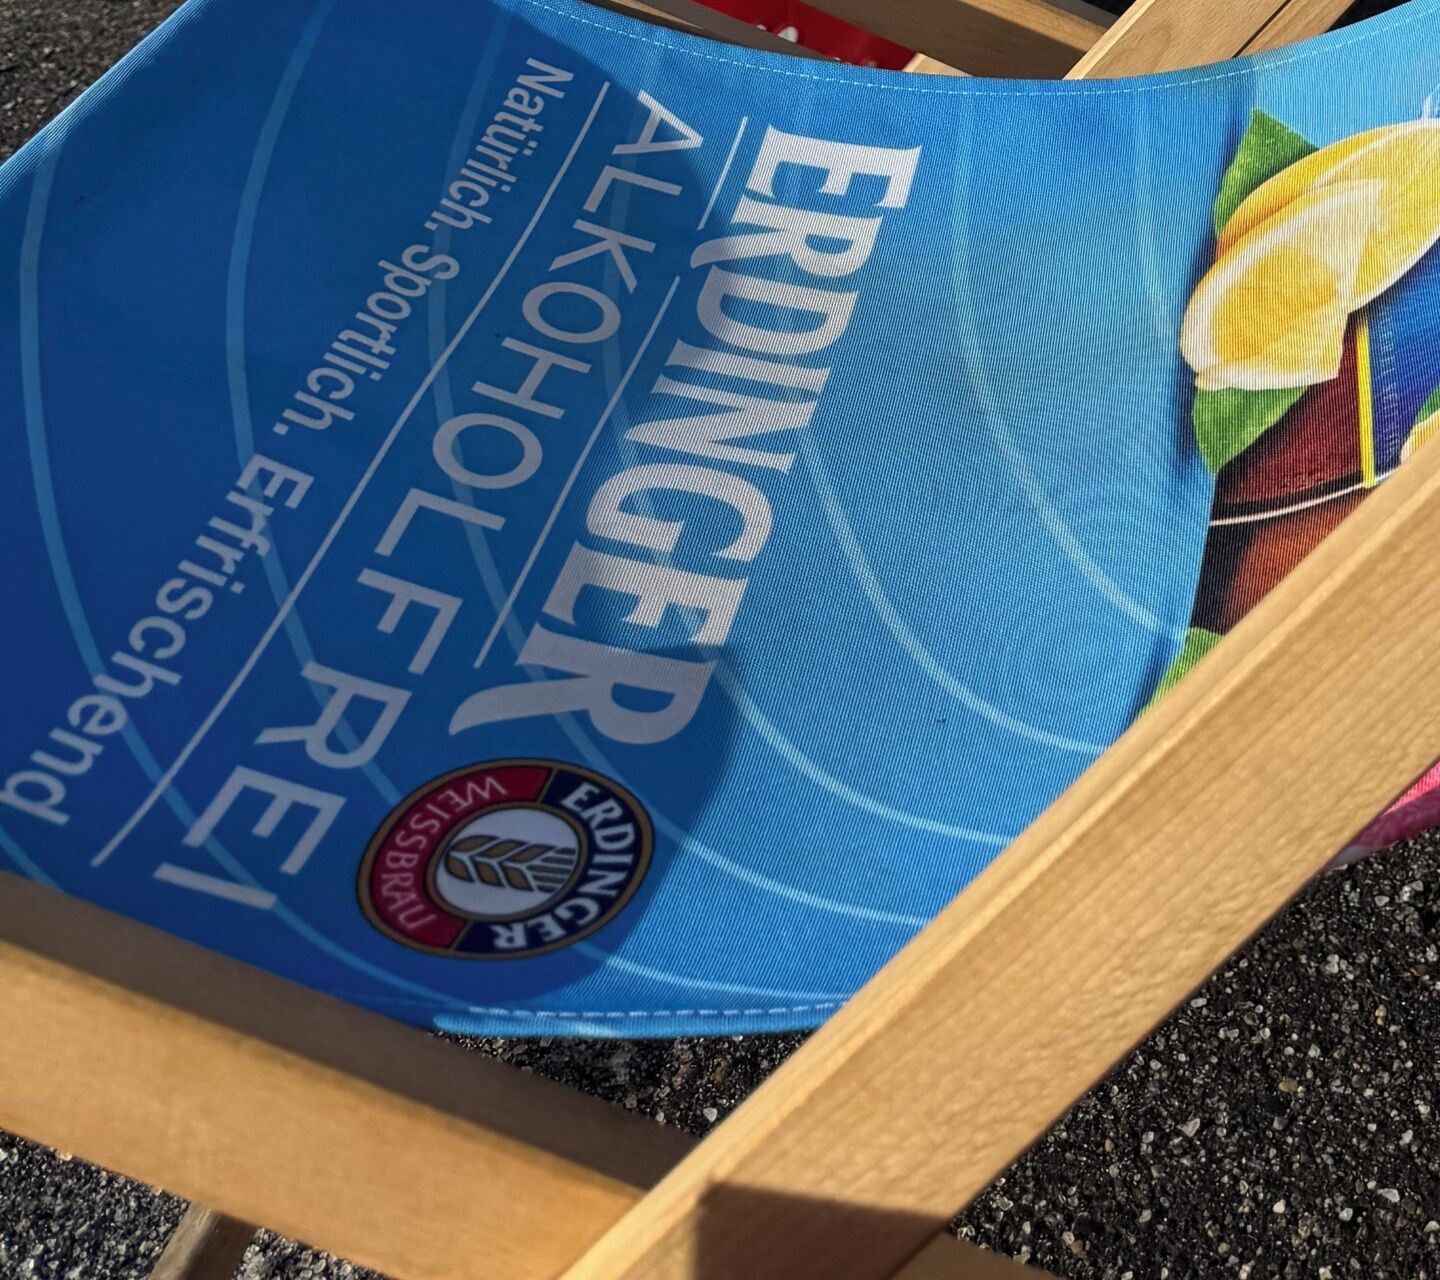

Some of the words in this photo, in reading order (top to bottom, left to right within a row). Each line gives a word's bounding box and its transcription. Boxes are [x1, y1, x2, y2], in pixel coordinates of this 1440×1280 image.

[426, 57, 575, 233] Natürlich.
[272, 242, 462, 436] Sportlich.
[448, 124, 924, 747] ERDINGER
[0, 452, 315, 826] Erfrischend
[153, 89, 705, 911] ALKOHOLFREI
[487, 780, 636, 951] ERDINGER
